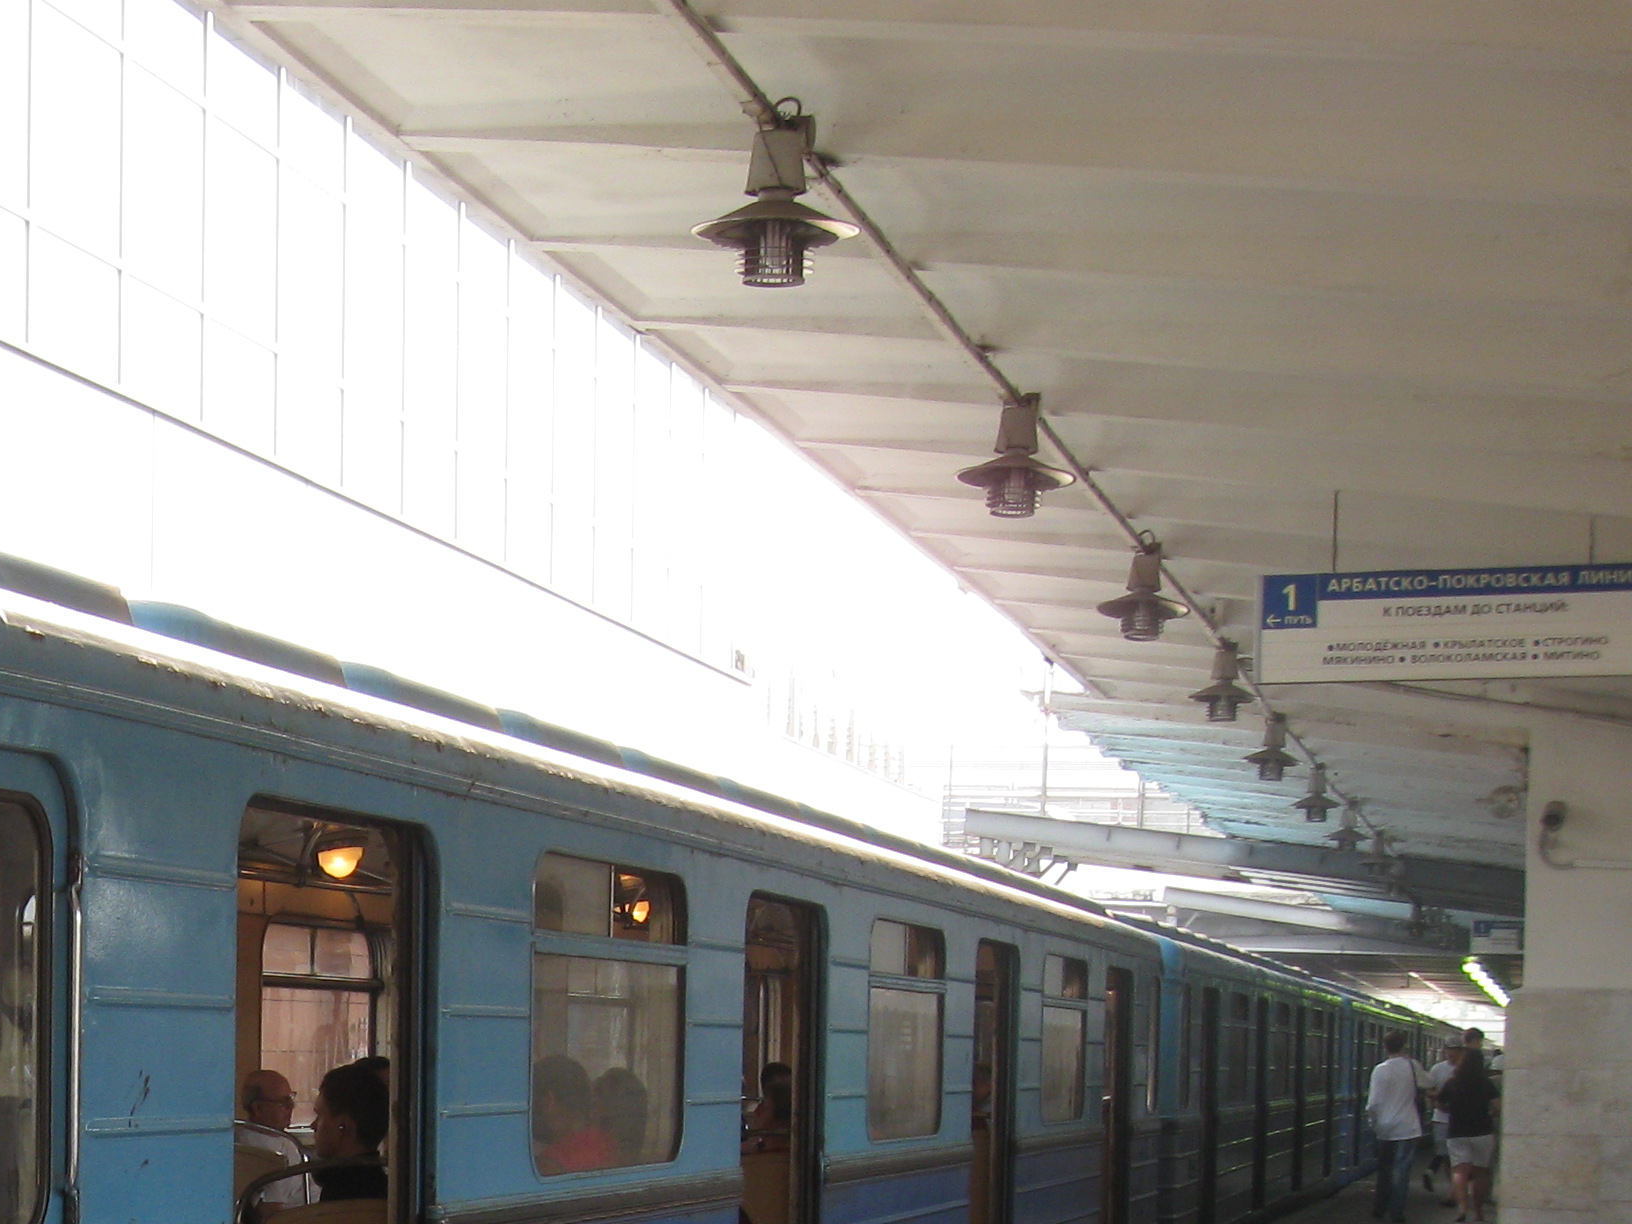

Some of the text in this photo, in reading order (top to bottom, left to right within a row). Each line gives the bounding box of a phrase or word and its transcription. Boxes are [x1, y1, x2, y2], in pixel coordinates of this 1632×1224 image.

[1282, 583, 1297, 612] 1
[1382, 606, 1393, 618] К
[1395, 603, 1467, 618] ПОЕЗДАМ
[1471, 602, 1492, 616] ДО
[1284, 613, 1313, 625] ПУТЬ
[1442, 638, 1525, 649] КРЫЛАТСКОЕ
[1542, 636, 1608, 647] СТРОГИНО
[1322, 650, 1600, 666] МЯКИНИНО ВОЛОКОЛАМСКАЯ МИТИНО
